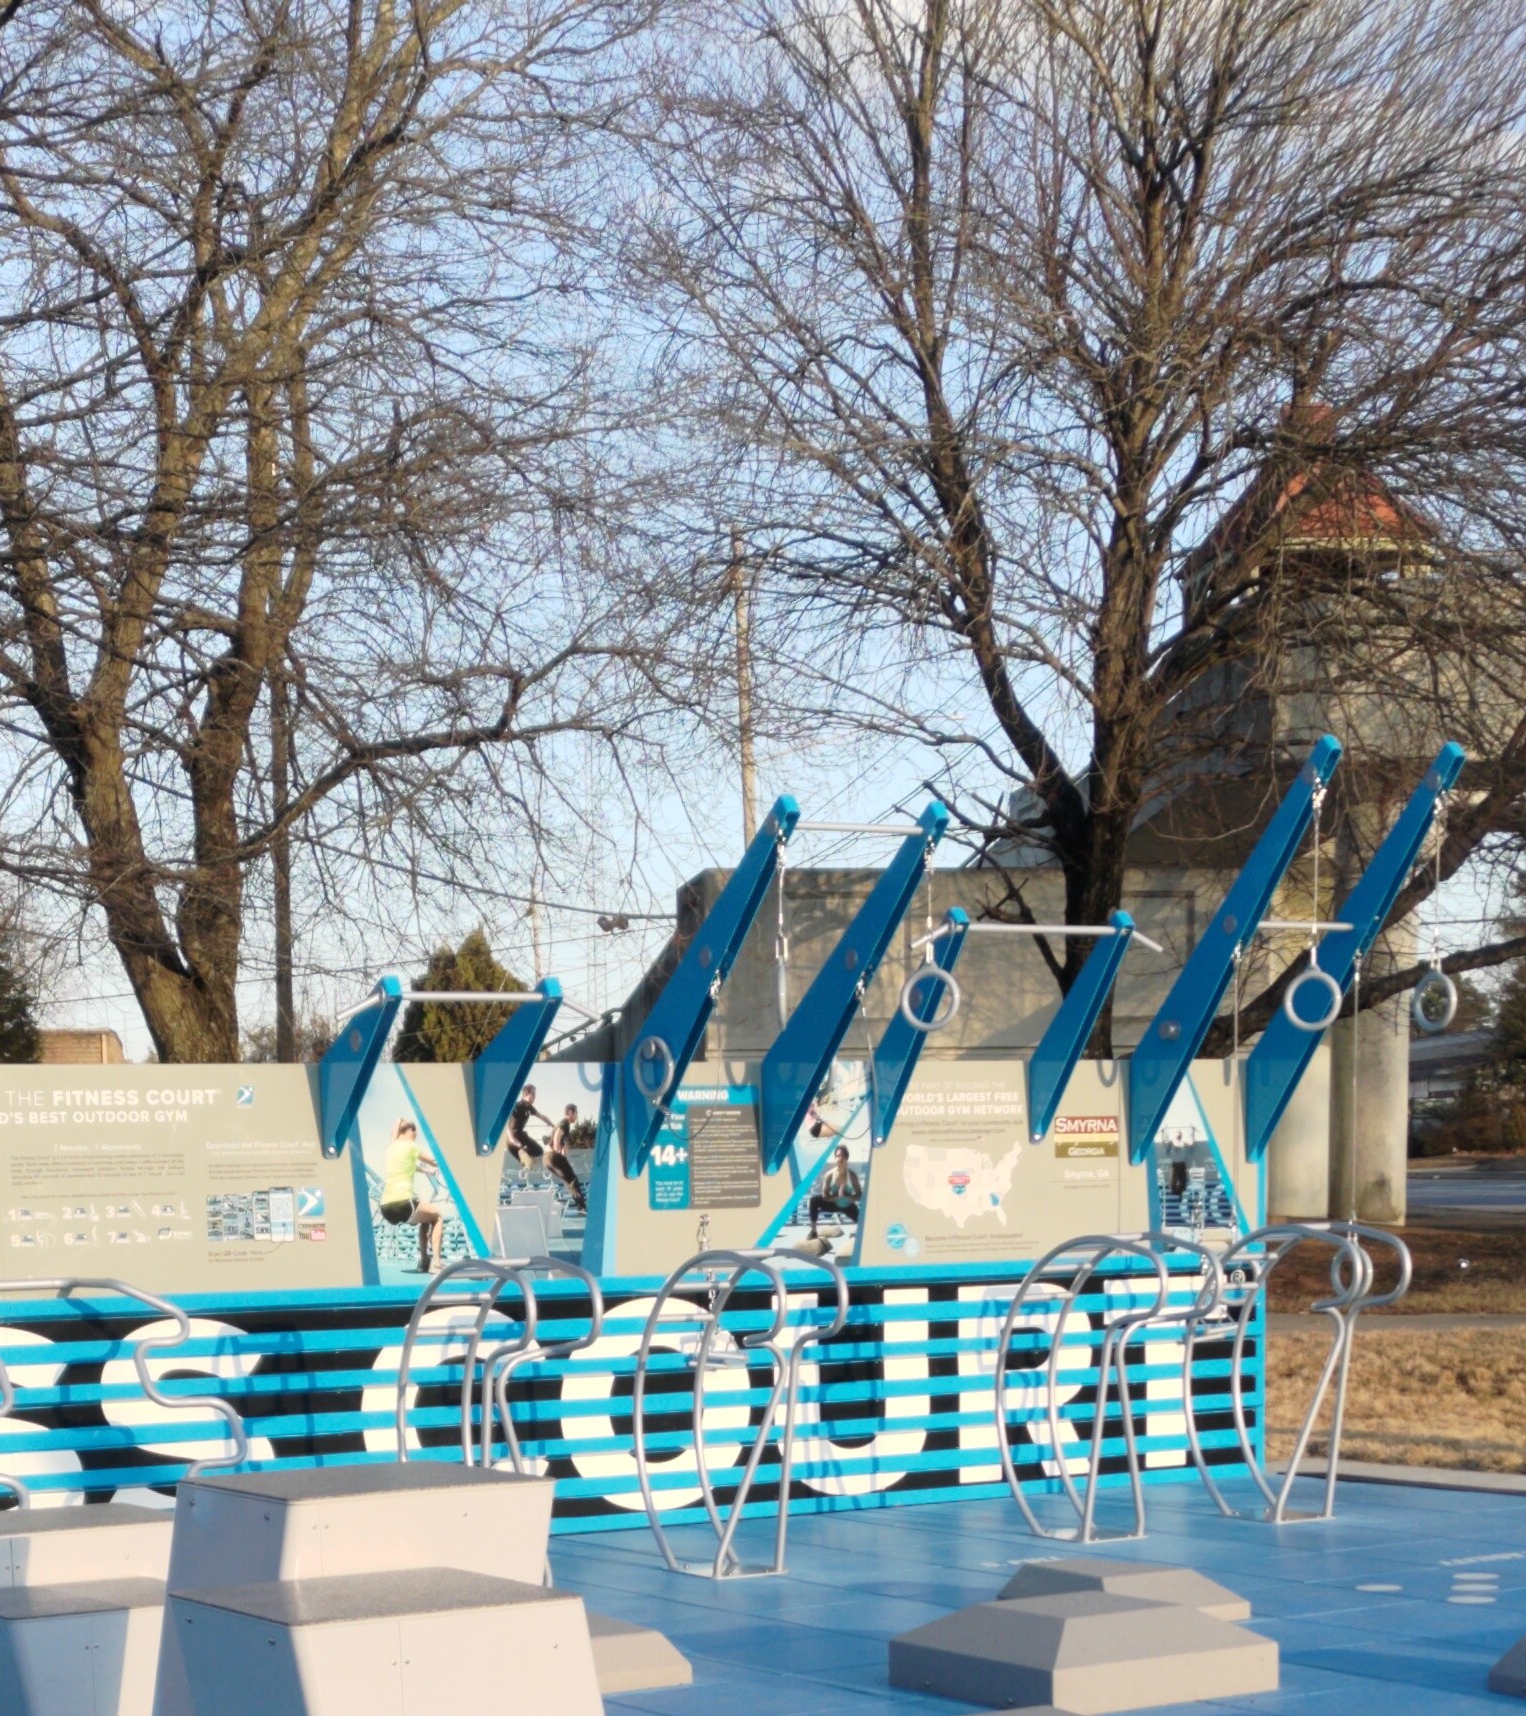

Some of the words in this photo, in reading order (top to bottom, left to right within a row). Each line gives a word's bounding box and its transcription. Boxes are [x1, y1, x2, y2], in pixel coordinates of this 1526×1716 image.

[5, 1090, 44, 1107] THE
[52, 1089, 139, 1106] FITNESS
[676, 1090, 729, 1100] WARNING
[903, 1092, 943, 1102] ORLD'S
[946, 1092, 991, 1102] LARGEST
[994, 1091, 1019, 1101] FREE
[29, 1111, 66, 1124] BEST
[73, 1111, 149, 1123] OUTDOOR
[155, 1110, 187, 1123] GYM
[897, 1105, 945, 1116] UTDOOR
[947, 1104, 971, 1115] GYM
[974, 1104, 1024, 1115] NETWORK
[1055, 1117, 1117, 1133] SMYRNA
[650, 1145, 688, 1166] 14+
[8, 1208, 16, 1221] 1
[62, 1207, 72, 1219] 2
[106, 1206, 115, 1218] 3
[151, 1204, 161, 1216] 4
[11, 1235, 21, 1247] 5
[63, 1233, 73, 1245] 6
[107, 1232, 117, 1244] 7
